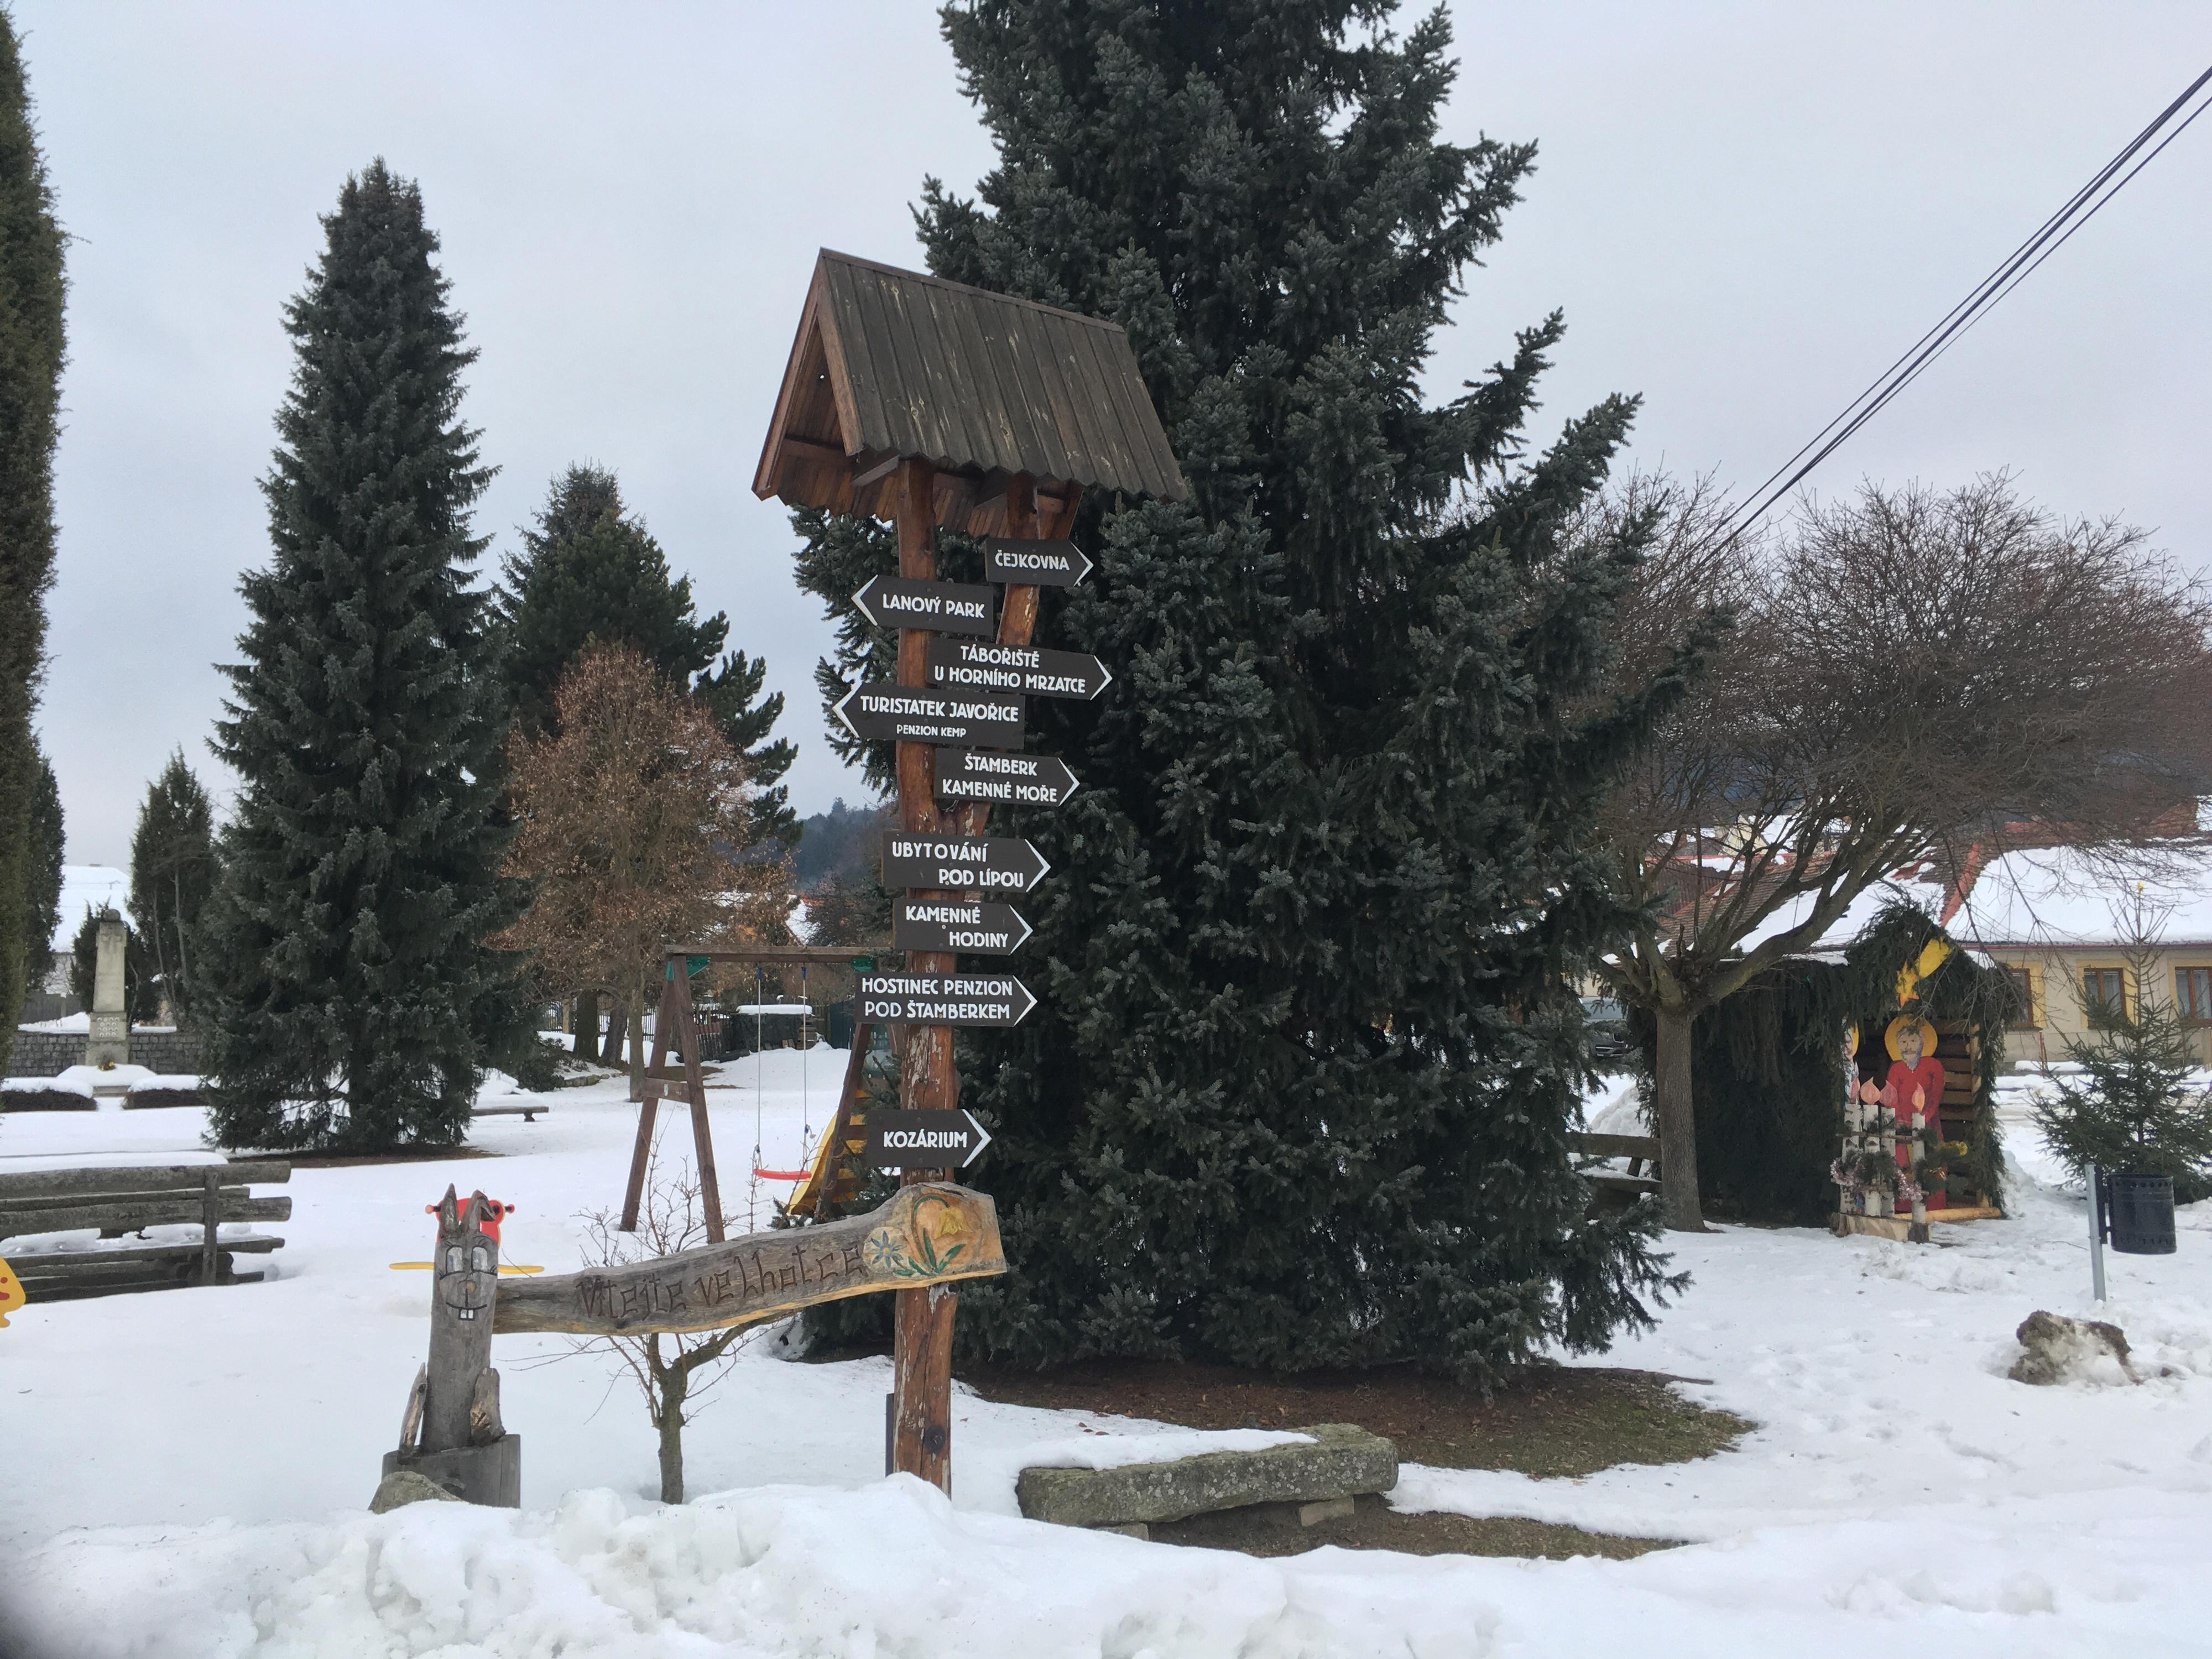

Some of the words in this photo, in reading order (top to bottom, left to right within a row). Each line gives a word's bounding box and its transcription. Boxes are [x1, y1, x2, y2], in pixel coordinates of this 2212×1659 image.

[995, 549, 1070, 571] ČEJKOVNA
[883, 593, 941, 614] LANOVÝ
[946, 600, 985, 618] PARK
[960, 643, 1040, 669] TÁBOŘIŠTĚ
[935, 666, 944, 681] U
[949, 666, 1021, 687] HORNÍHO
[1025, 674, 1086, 693] MRZATCE
[860, 695, 946, 717] TURISTATEK
[949, 702, 1019, 722] JAVOŘICE
[896, 724, 938, 736] PENZION
[941, 727, 967, 738] KEMP
[964, 753, 1037, 776] ŠTAMBERK
[942, 779, 1012, 799] KAMENNÉ
[1016, 784, 1057, 802] MOŘE
[892, 841, 989, 863] UBYTOVÁNÍ
[938, 868, 974, 885] POD
[979, 868, 1024, 888] LÍPOU
[906, 905, 981, 924] KAMENNÉ
[949, 931, 1009, 948] HODINY
[862, 977, 938, 995] HOSTINEC
[944, 979, 1013, 996] PENZION
[865, 1001, 902, 1018] POD
[906, 999, 1010, 1020] ŠTAMBERKEM
[883, 1128, 967, 1149] KOZÁRIUM
